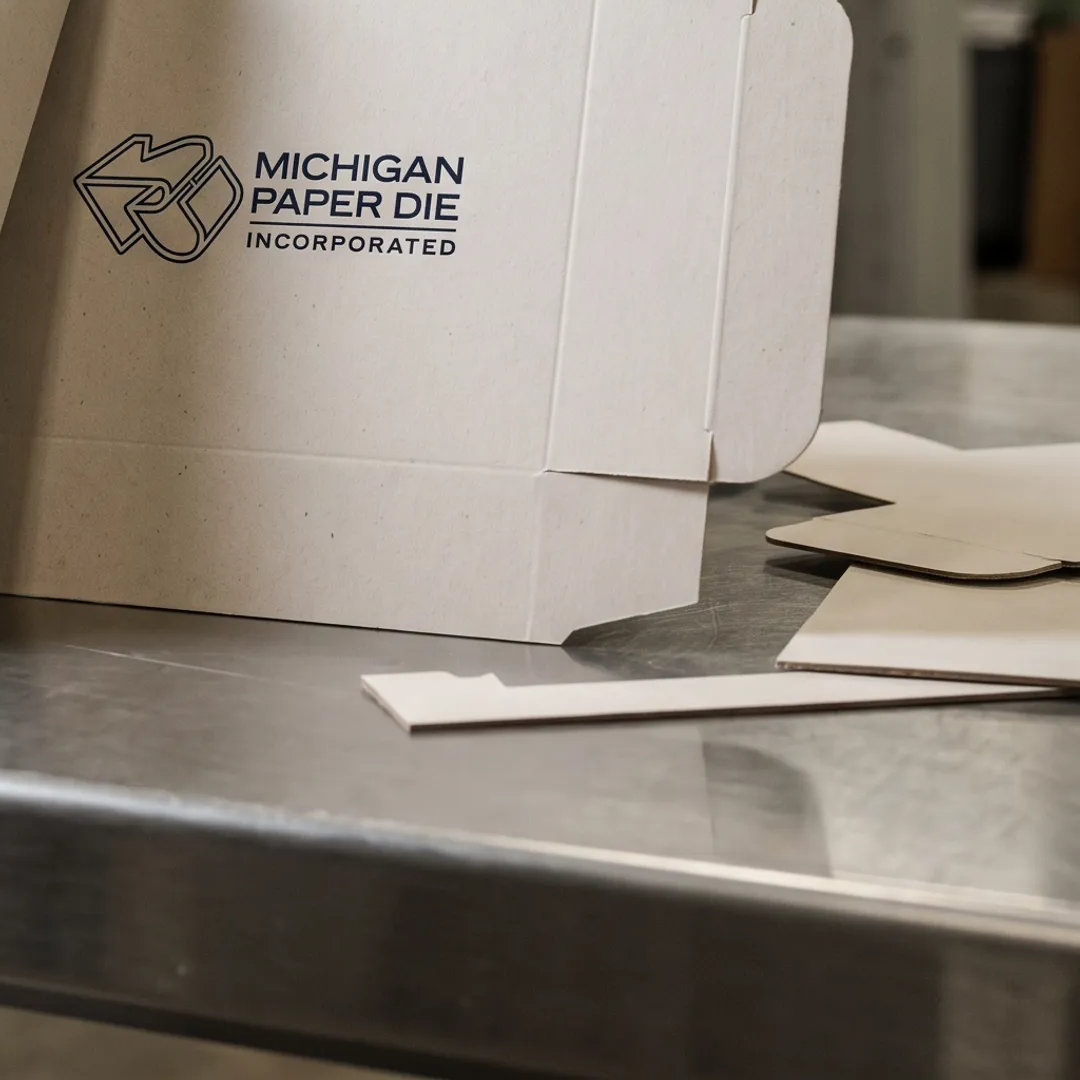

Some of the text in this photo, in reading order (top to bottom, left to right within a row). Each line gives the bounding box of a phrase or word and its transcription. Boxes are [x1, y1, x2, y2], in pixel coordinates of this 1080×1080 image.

[254, 151, 465, 184] MICHIGAN
[250, 187, 461, 221] PAPER DIE
[246, 231, 457, 256] INCORPORATED
